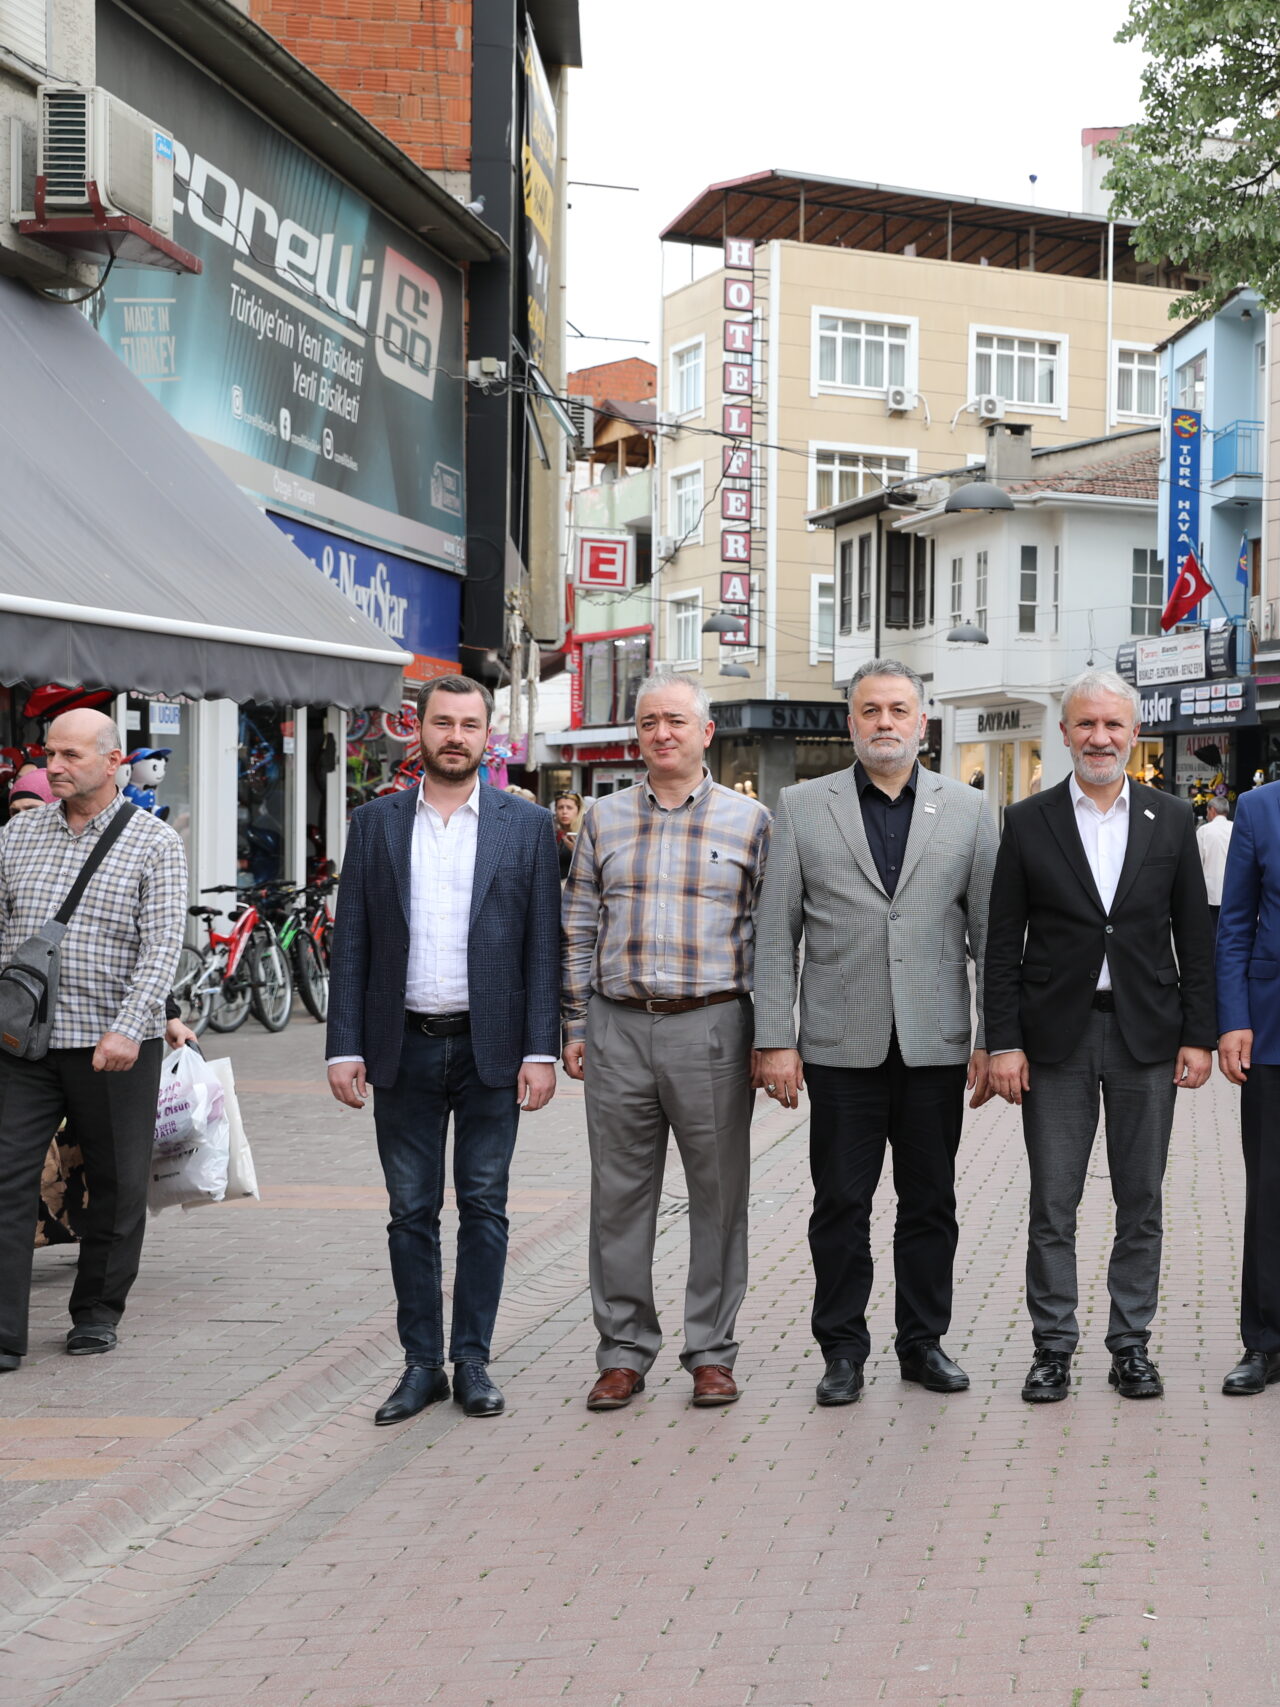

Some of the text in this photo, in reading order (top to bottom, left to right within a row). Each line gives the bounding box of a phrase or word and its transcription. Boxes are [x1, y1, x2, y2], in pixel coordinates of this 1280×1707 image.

[123, 306, 170, 332] MADE IN
[229, 283, 364, 387] Türkiye'nin Yeni Bisikleti
[727, 240, 751, 434] HOTEL
[120, 336, 176, 375] TURKEY
[292, 361, 360, 424] Yerli Bisikleti
[1178, 444, 1192, 488] TÜRK
[1177, 500, 1191, 543] HAVA
[589, 545, 618, 580] E
[978, 709, 1020, 733] BAYRAM
